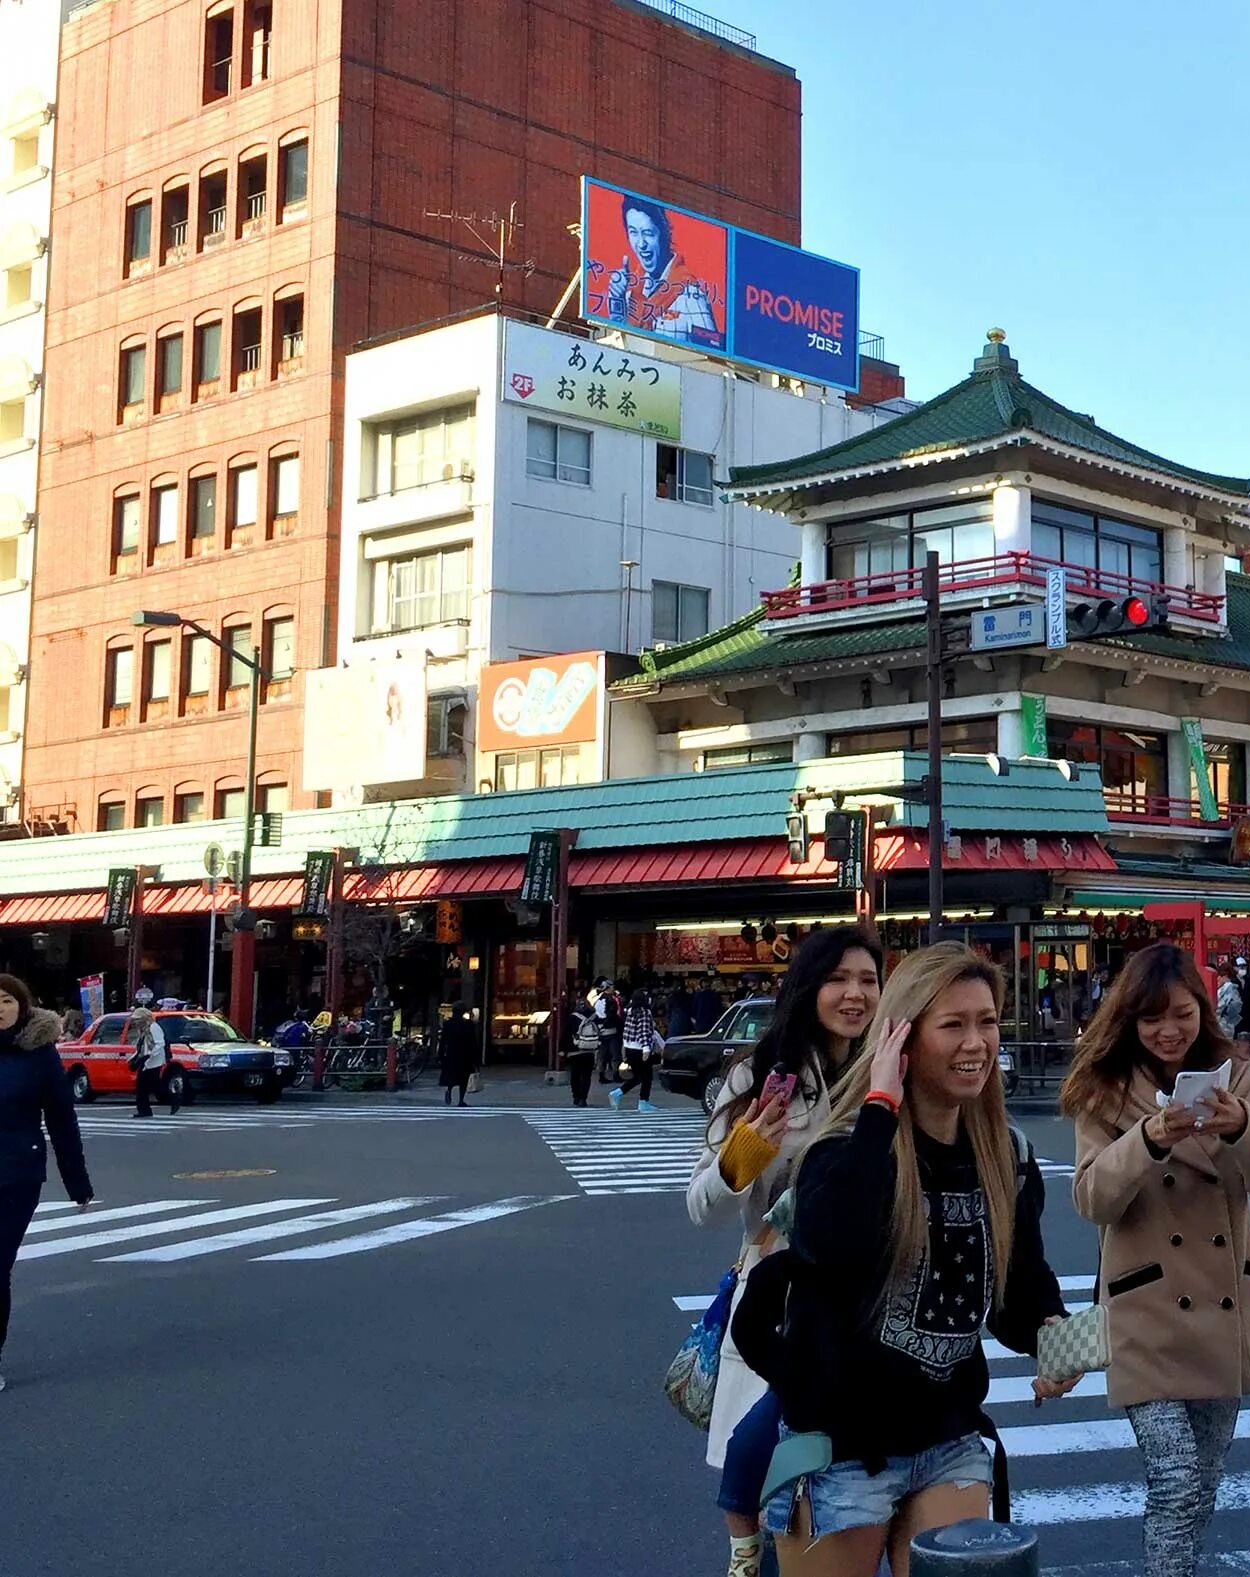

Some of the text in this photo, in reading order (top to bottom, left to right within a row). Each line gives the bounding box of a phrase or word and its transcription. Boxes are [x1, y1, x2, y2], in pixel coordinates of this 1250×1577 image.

[745, 284, 844, 338] PROMISE
[568, 344, 660, 386] あんみつ
[807, 333, 843, 356] プロミス
[514, 377, 532, 393] 2F
[557, 376, 637, 418] お抹茶
[1051, 571, 1062, 646] スクランブル式
[984, 631, 1032, 643] Kaminarimon
